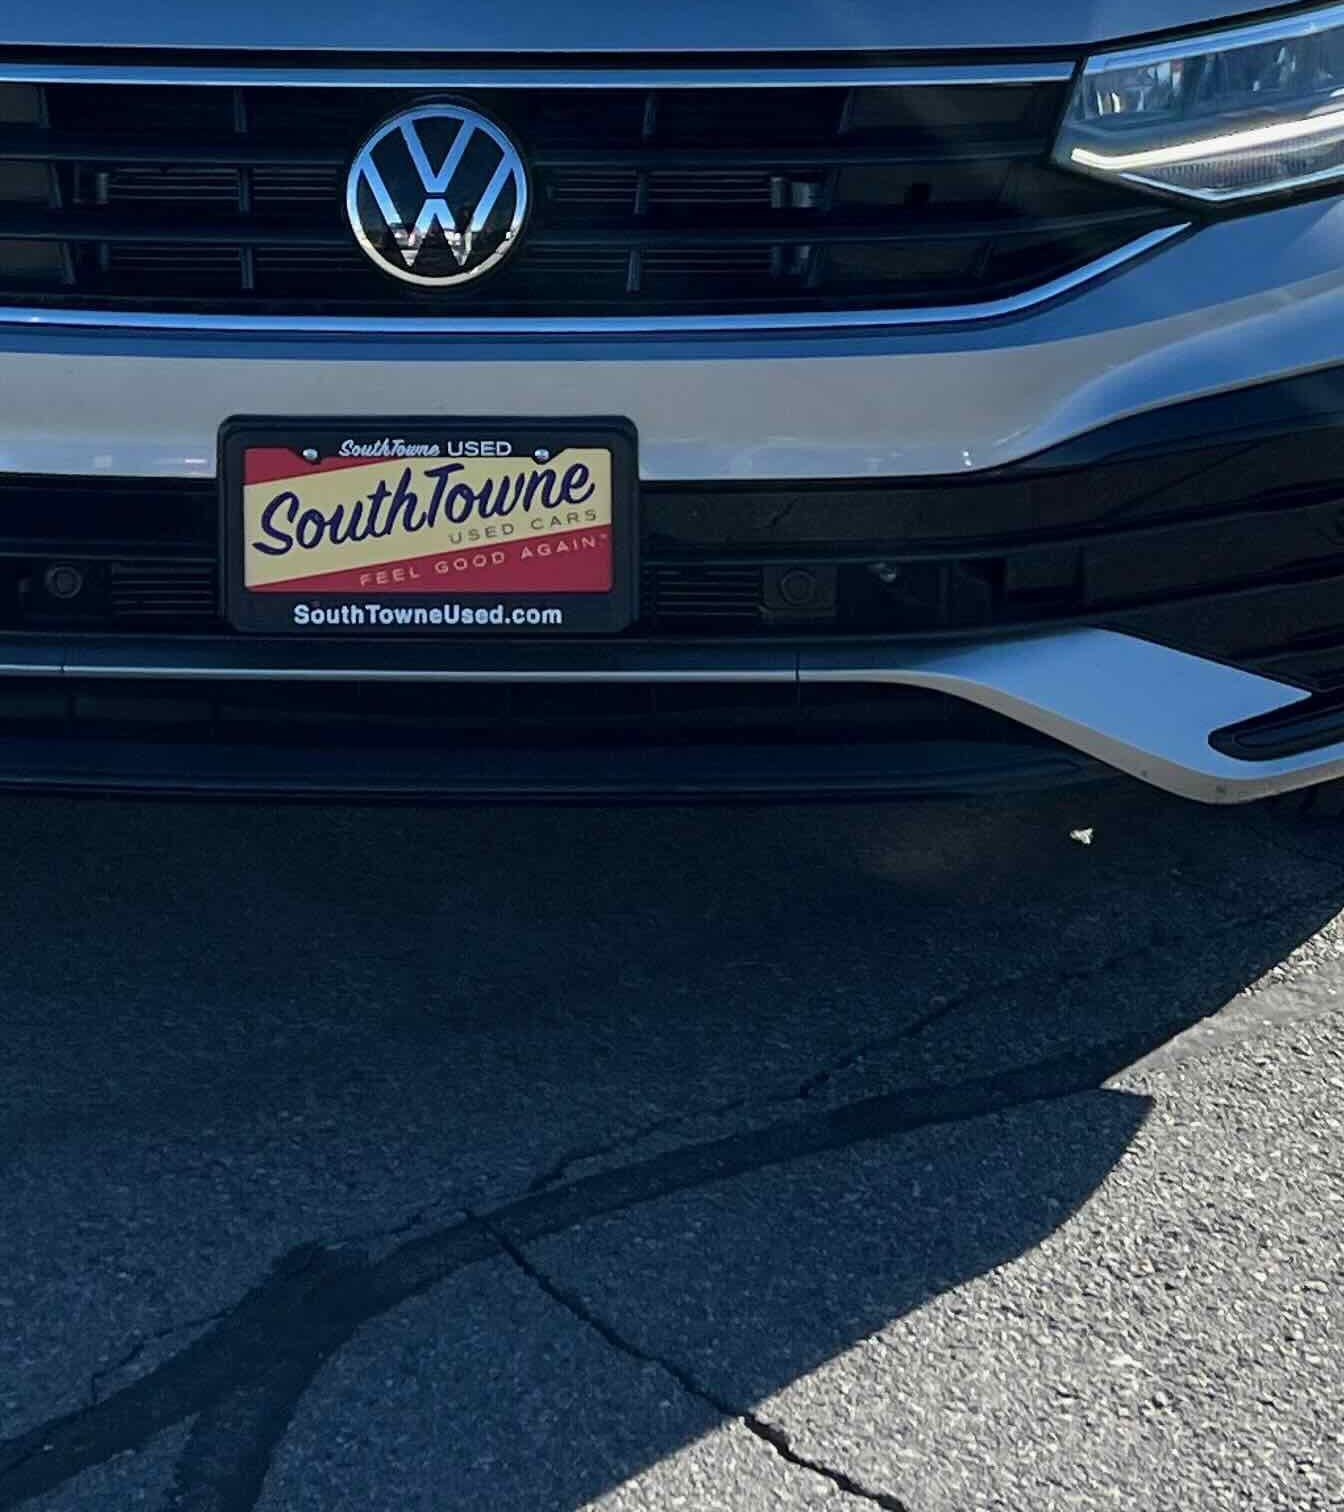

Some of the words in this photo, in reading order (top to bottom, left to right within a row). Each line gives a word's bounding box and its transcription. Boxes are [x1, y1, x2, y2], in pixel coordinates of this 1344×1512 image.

[337, 437, 441, 458] SouthTowne
[447, 440, 512, 457] USED
[252, 462, 596, 556] SouthTowne
[447, 522, 515, 545] USED
[530, 509, 597, 530] CARS
[359, 566, 421, 587] FEEL
[434, 551, 505, 575] GOOD
[294, 604, 563, 626] SouthTowneUsed.com
